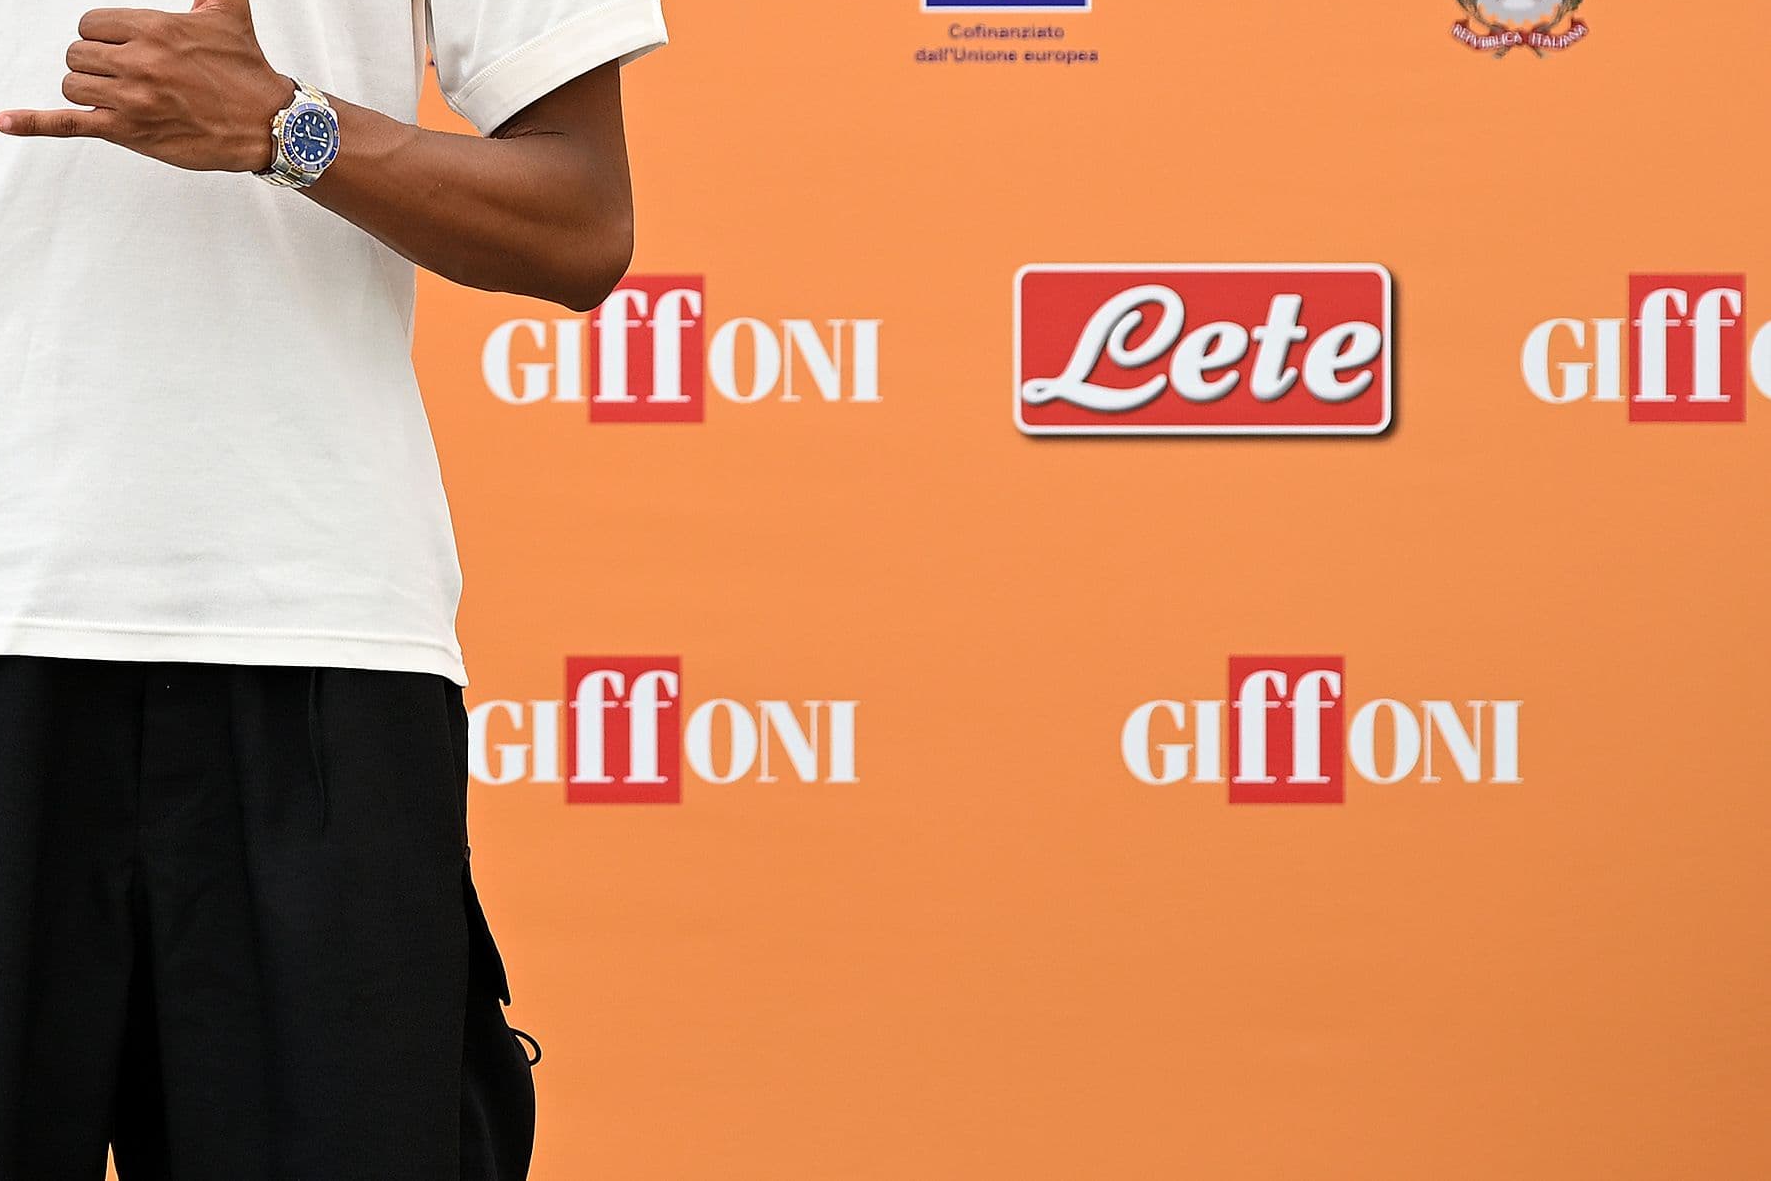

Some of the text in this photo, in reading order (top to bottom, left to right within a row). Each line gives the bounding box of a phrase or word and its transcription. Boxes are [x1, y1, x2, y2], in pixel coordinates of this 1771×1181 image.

[915, 47, 1099, 64] dall'Unione europea
[949, 23, 1065, 39] Cofinanziato
[482, 289, 884, 406] GIffONI
[1021, 284, 1383, 411] Lete
[1521, 288, 1771, 405] GIff
[1122, 670, 1524, 786] GIffONI
